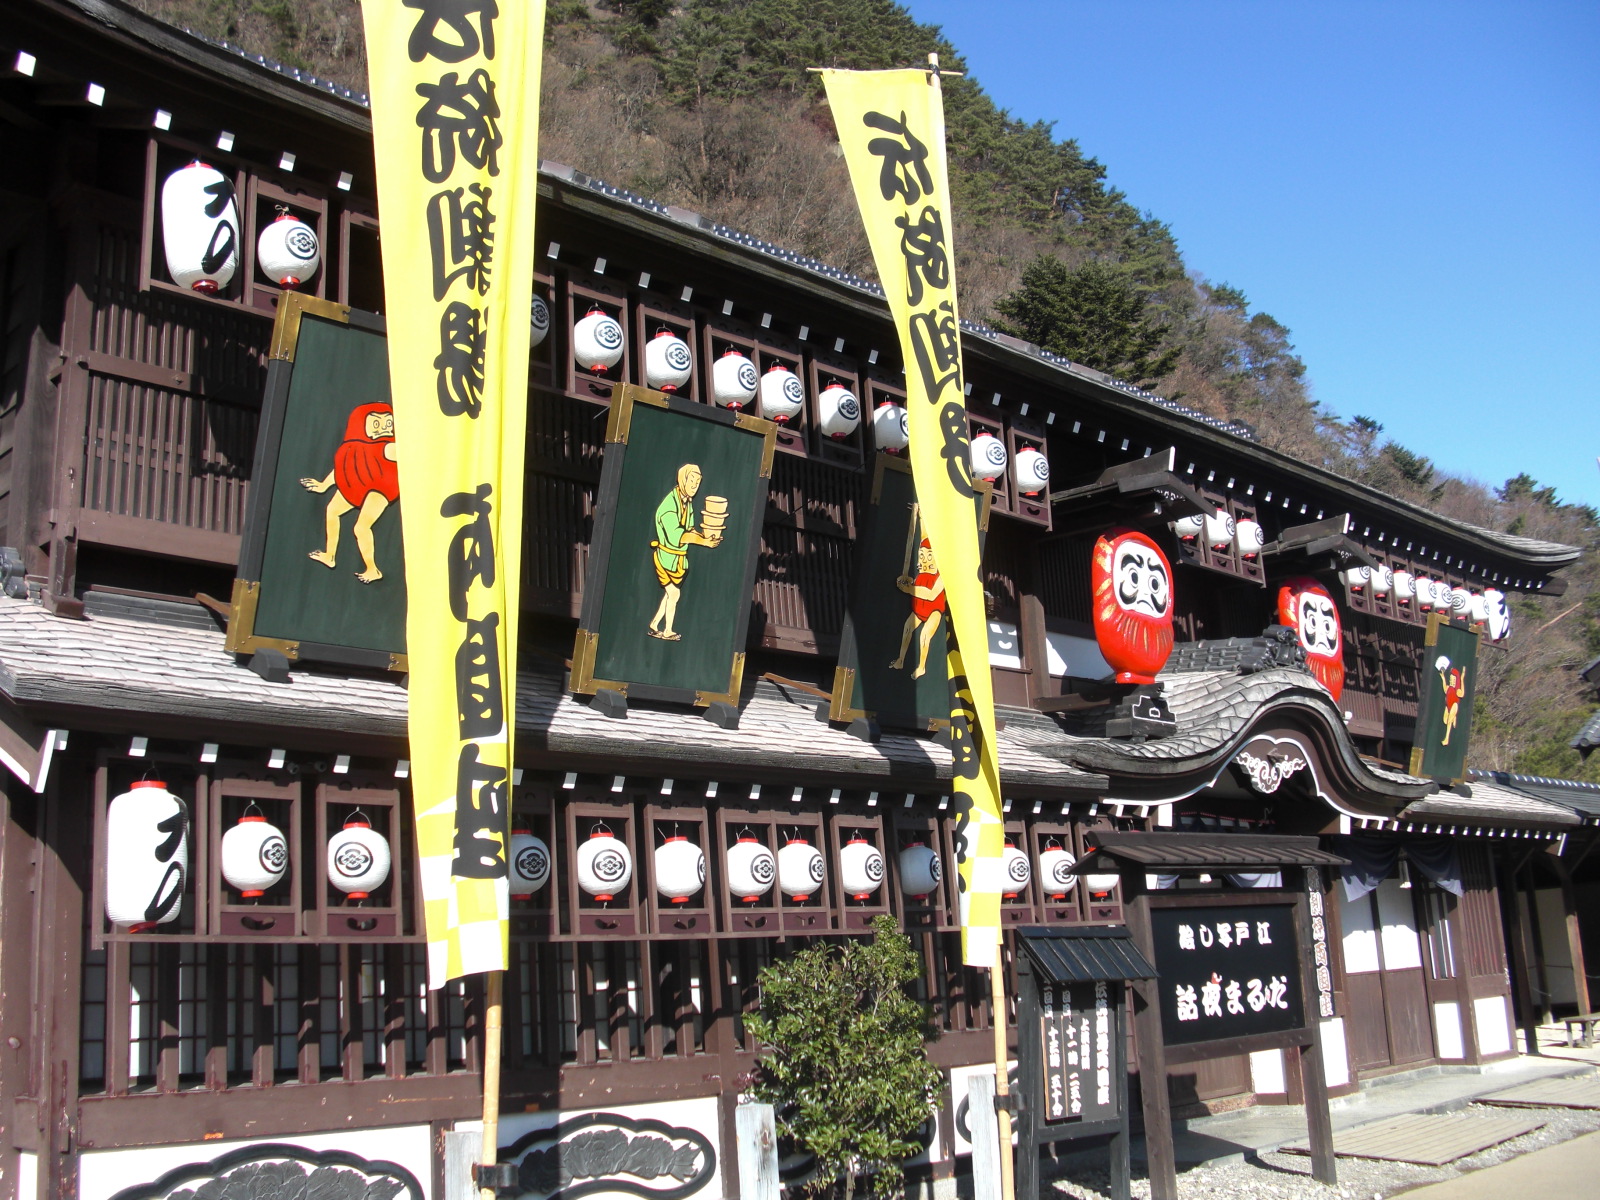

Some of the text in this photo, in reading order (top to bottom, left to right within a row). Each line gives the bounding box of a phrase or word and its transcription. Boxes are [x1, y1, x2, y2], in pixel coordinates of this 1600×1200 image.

[1178, 921, 1272, 950] 江戸写し絵
[1176, 975, 1289, 1021] だるま夜話
